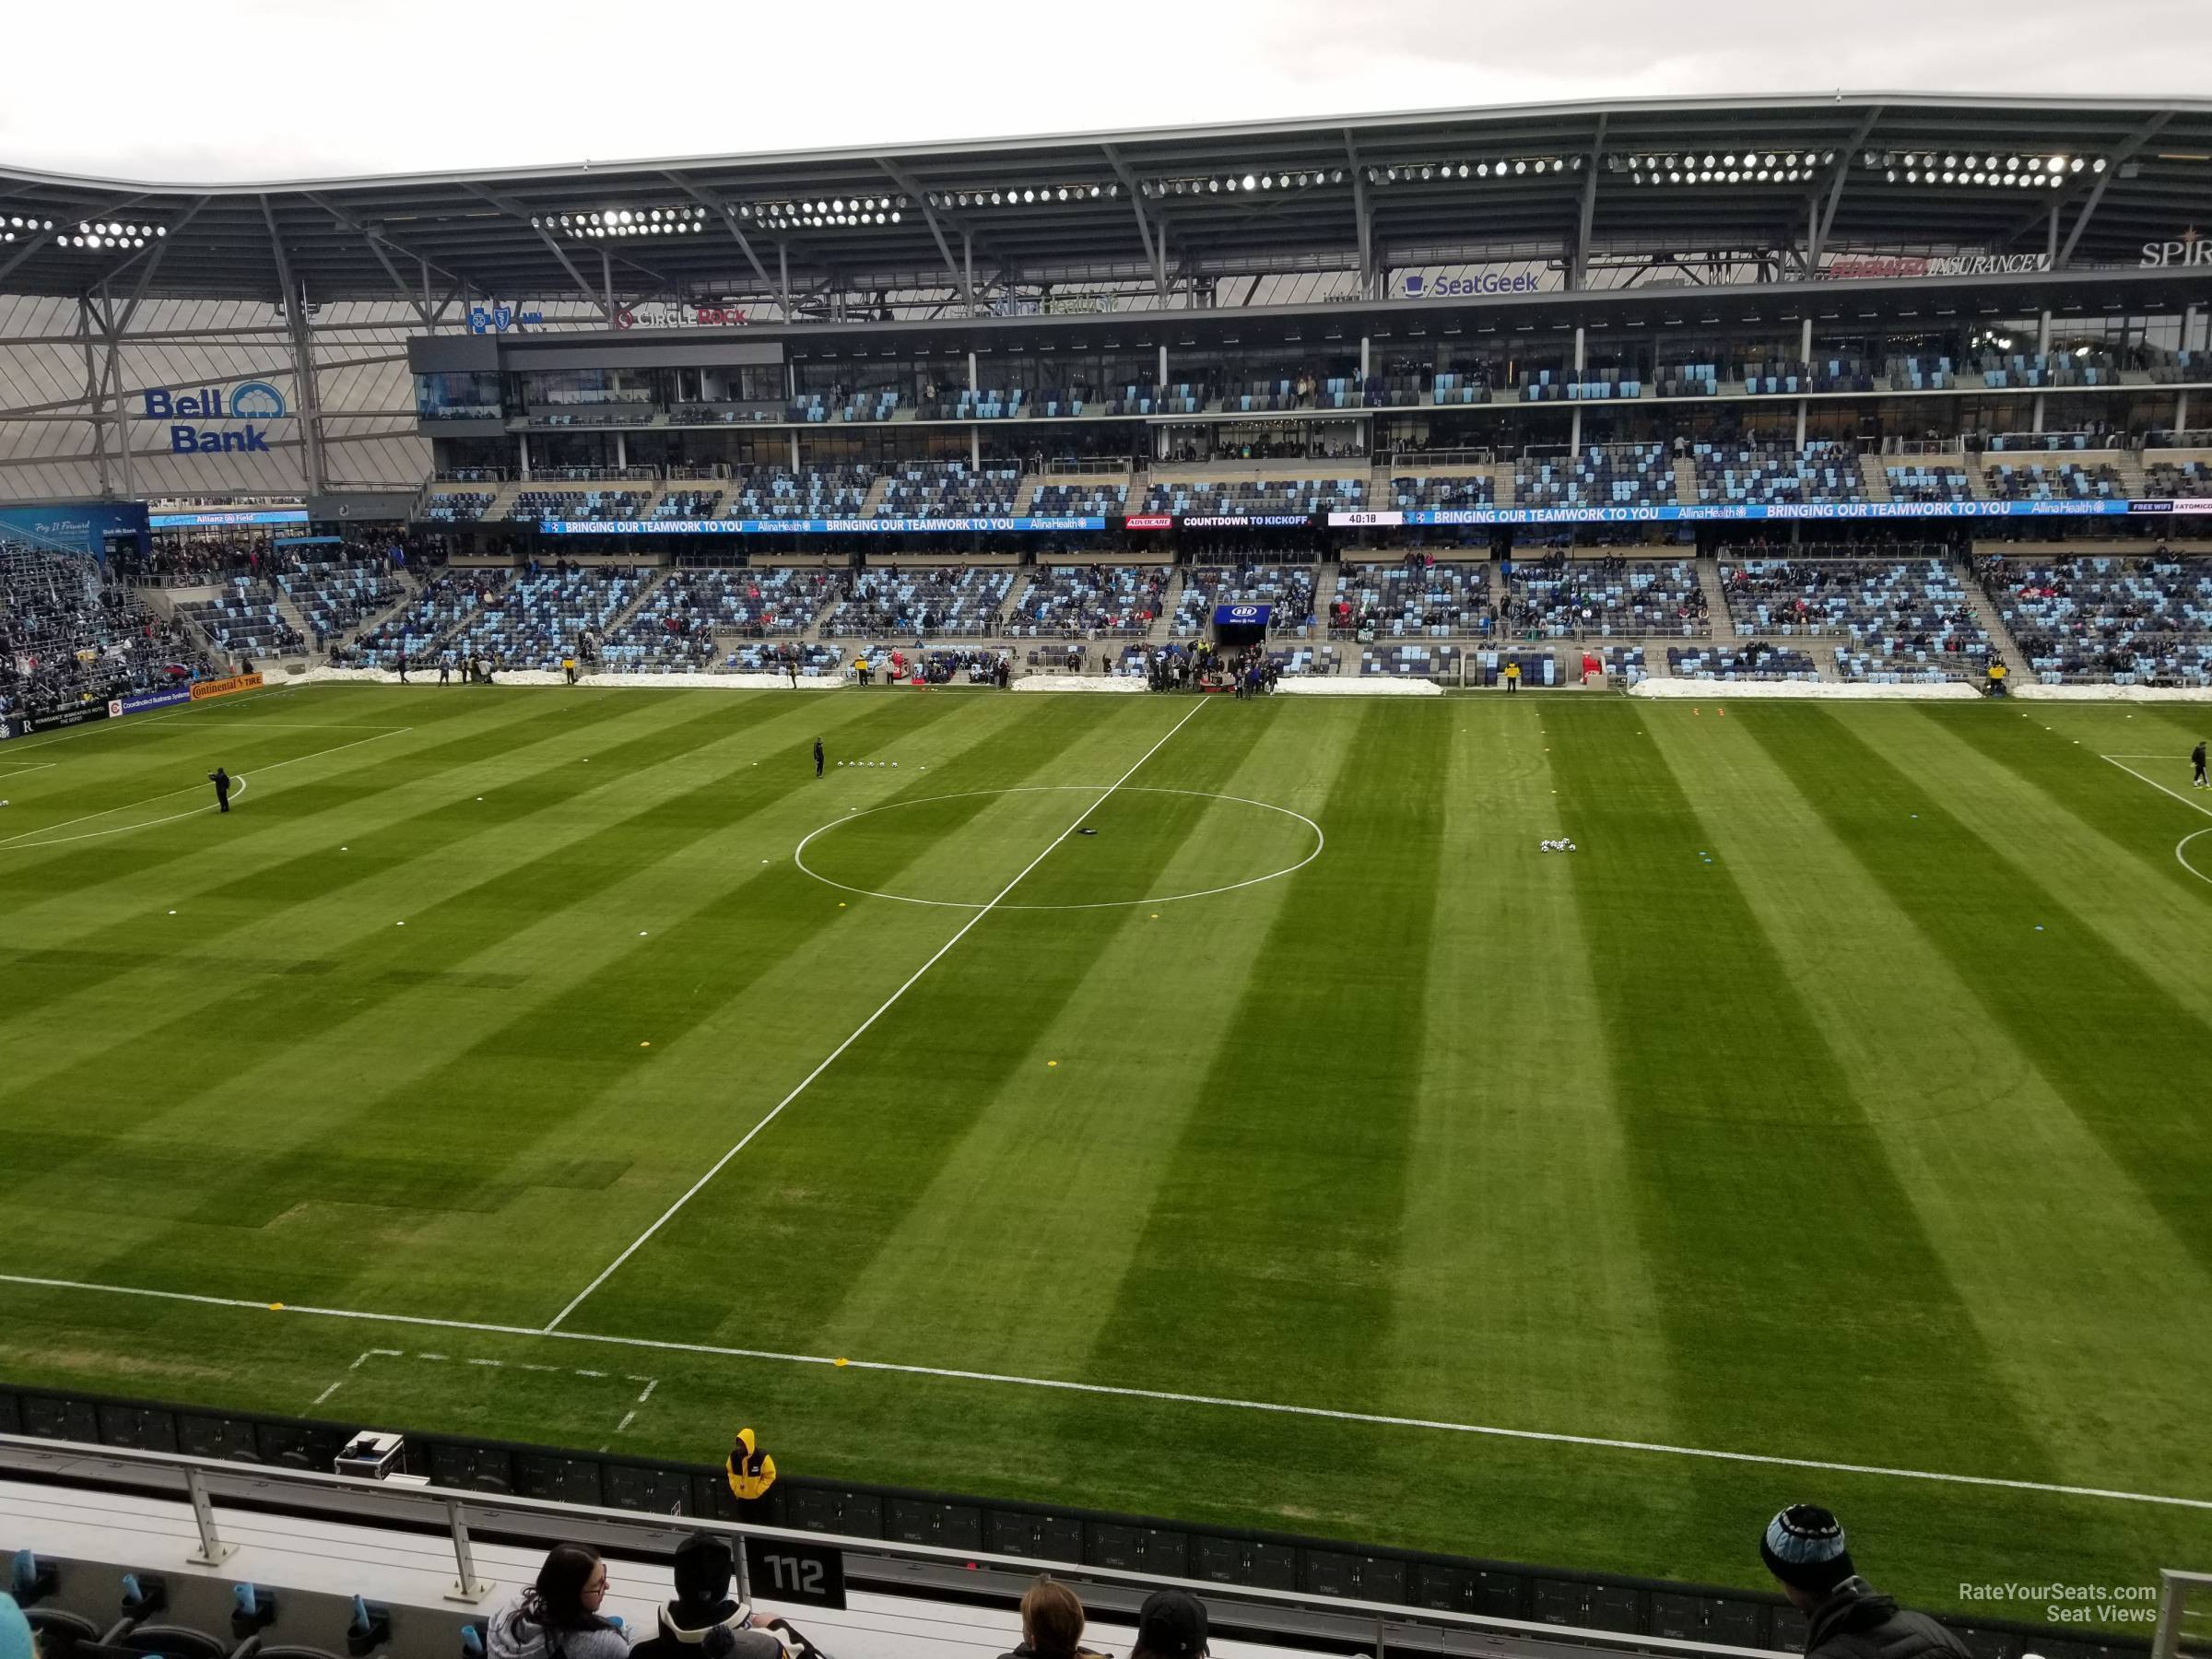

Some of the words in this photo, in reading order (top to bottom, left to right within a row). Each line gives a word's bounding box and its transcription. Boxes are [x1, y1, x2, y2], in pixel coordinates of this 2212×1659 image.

[2139, 241, 2212, 268] SPIR
[1927, 254, 2036, 276] INSURANCE
[1435, 272, 1538, 296] SeatGeek
[145, 389, 222, 418] Bell
[171, 424, 270, 453] Bank
[1434, 511, 1495, 523] BRINGING
[1499, 510, 1526, 522] OUR
[1529, 508, 1606, 522] TEAMWORK
[1609, 508, 1627, 520] TO
[1630, 507, 1659, 520] YOU
[1767, 504, 1833, 517] BRINGING
[1837, 504, 1866, 516] OUR
[1870, 502, 1953, 516] TEAMWORK
[1957, 502, 1976, 514] TO
[1981, 501, 2011, 514] YOU
[566, 522, 615, 533] BRINGING
[617, 522, 639, 533] OUR
[641, 521, 700, 533] TEAMWORK
[703, 521, 718, 532] TO
[720, 521, 743, 532] YOU
[826, 520, 877, 531] BRINGING
[881, 520, 904, 531] OUR
[906, 519, 970, 531] TEAMWORK
[972, 518, 987, 529] TO
[990, 518, 1014, 529] YOU
[1183, 516, 1248, 526] COUNTDOWN
[1249, 516, 1264, 525] TO
[1349, 514, 1376, 524] 40:18
[193, 679, 237, 699] Continental
[244, 677, 262, 687] TIRE
[23, 720, 34, 733] R
[764, 1555, 826, 1594] 112
